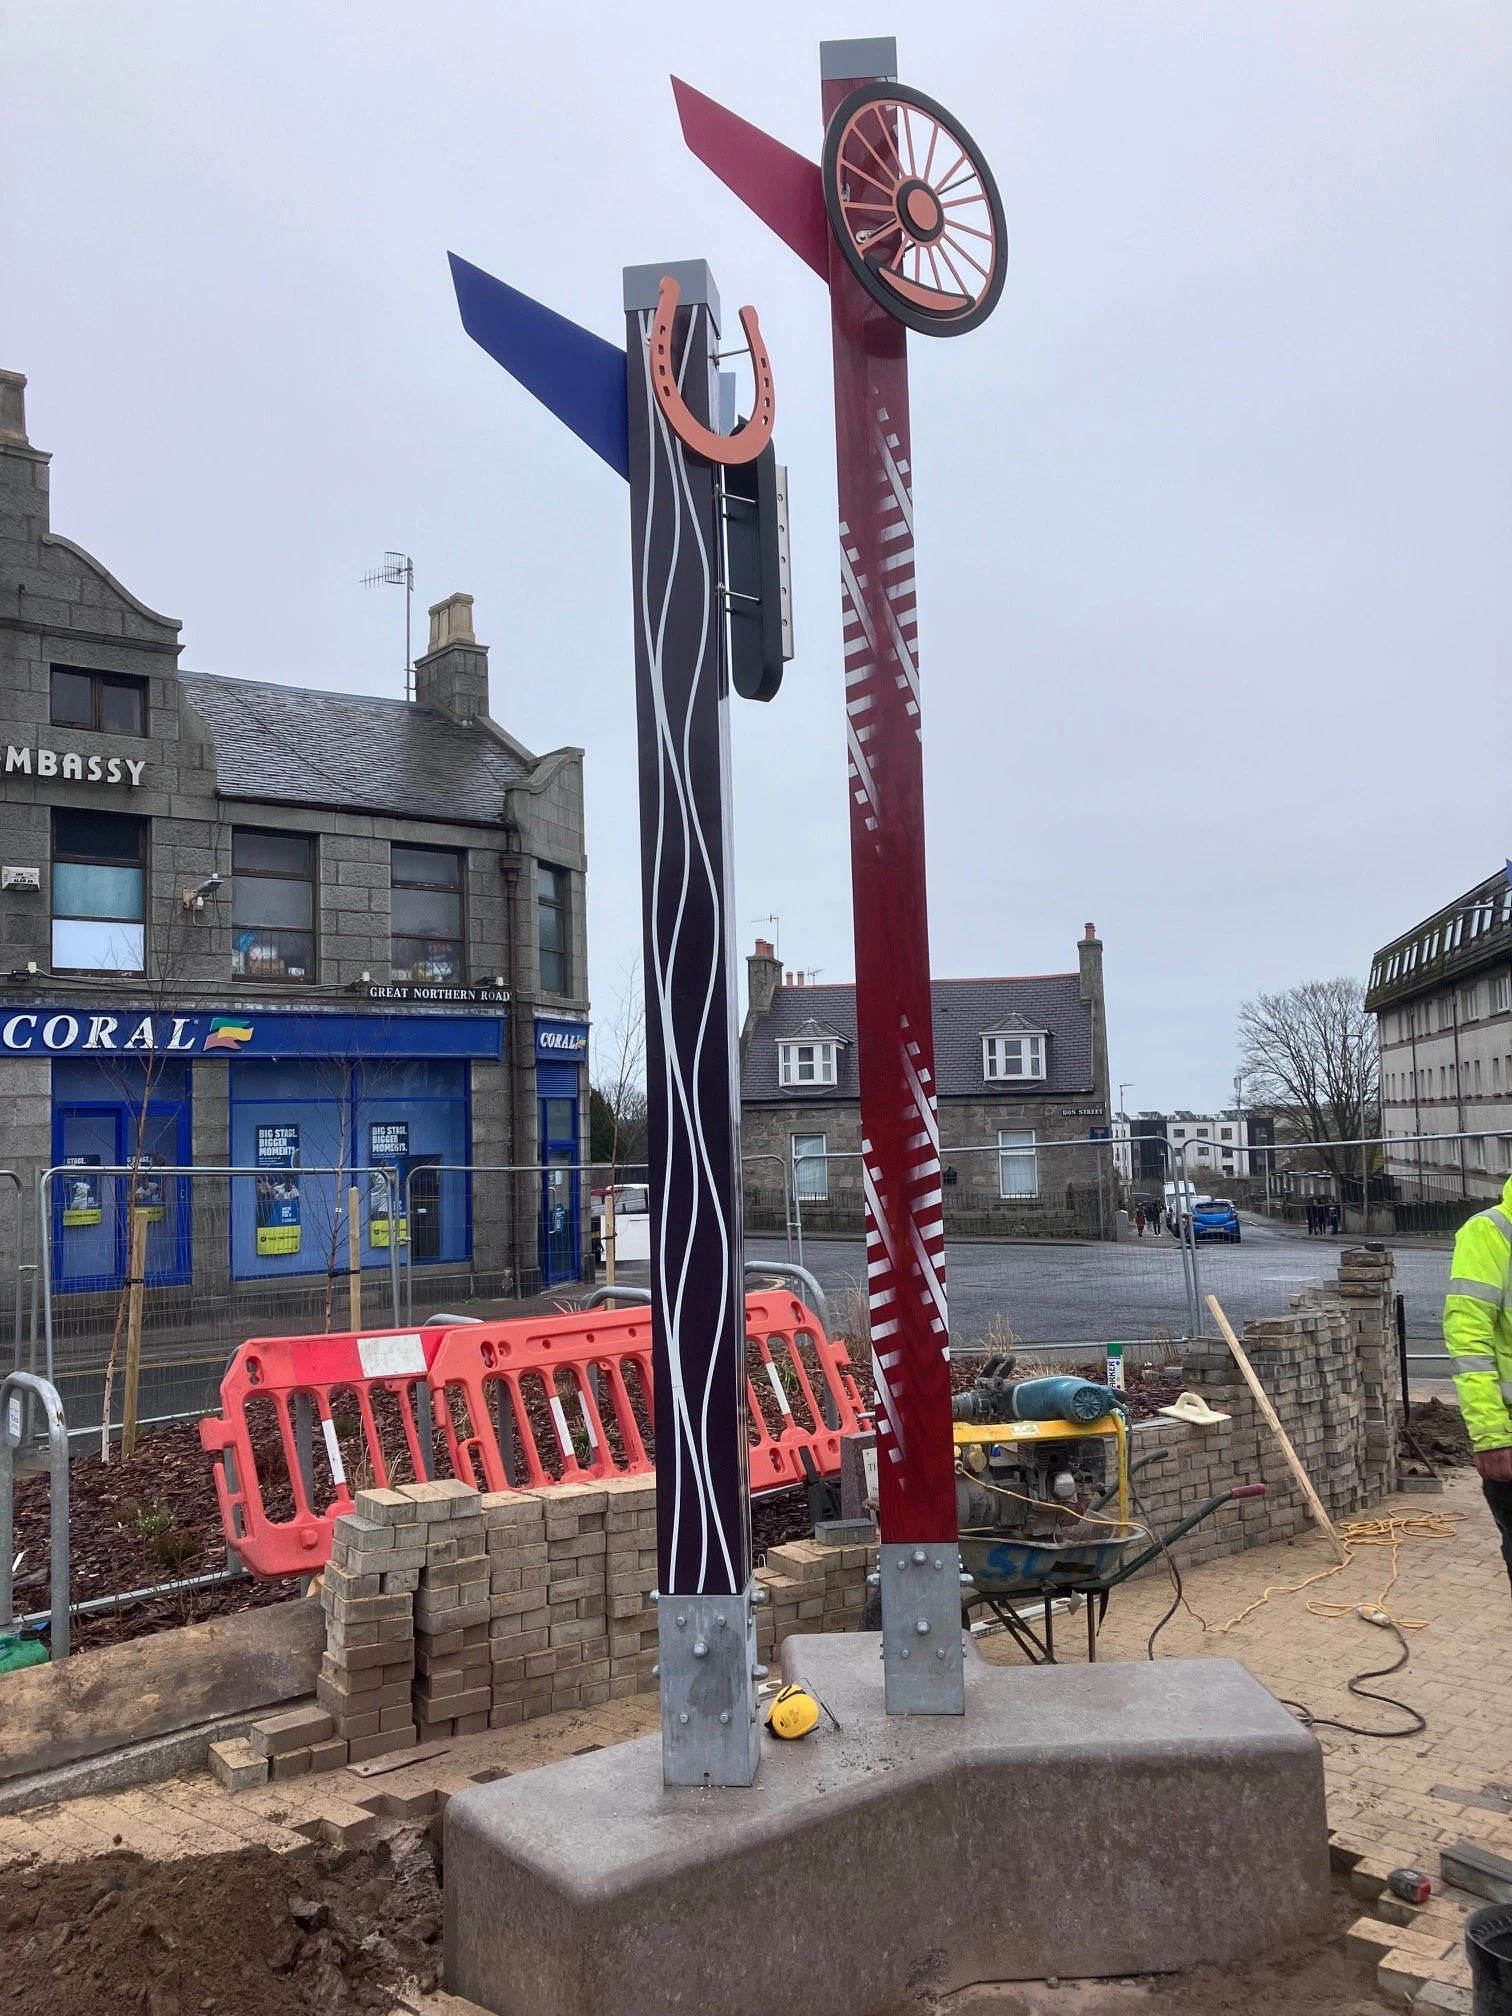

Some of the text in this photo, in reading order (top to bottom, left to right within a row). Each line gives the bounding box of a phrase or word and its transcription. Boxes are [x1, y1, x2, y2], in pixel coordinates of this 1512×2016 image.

[0, 746, 145, 785] MBASSY
[370, 987, 510, 1002] GREAT NORTHERN ROAD
[2, 1014, 197, 1050] CORAL
[540, 1032, 575, 1049] CORAL
[258, 1129, 273, 1138] BIG
[372, 1126, 386, 1135] BIG
[258, 1138, 287, 1147] BIGGER
[372, 1135, 399, 1144] BIGGER
[372, 1143, 408, 1152] MOMENTS.
[1108, 1360, 1116, 1388] ARKER
